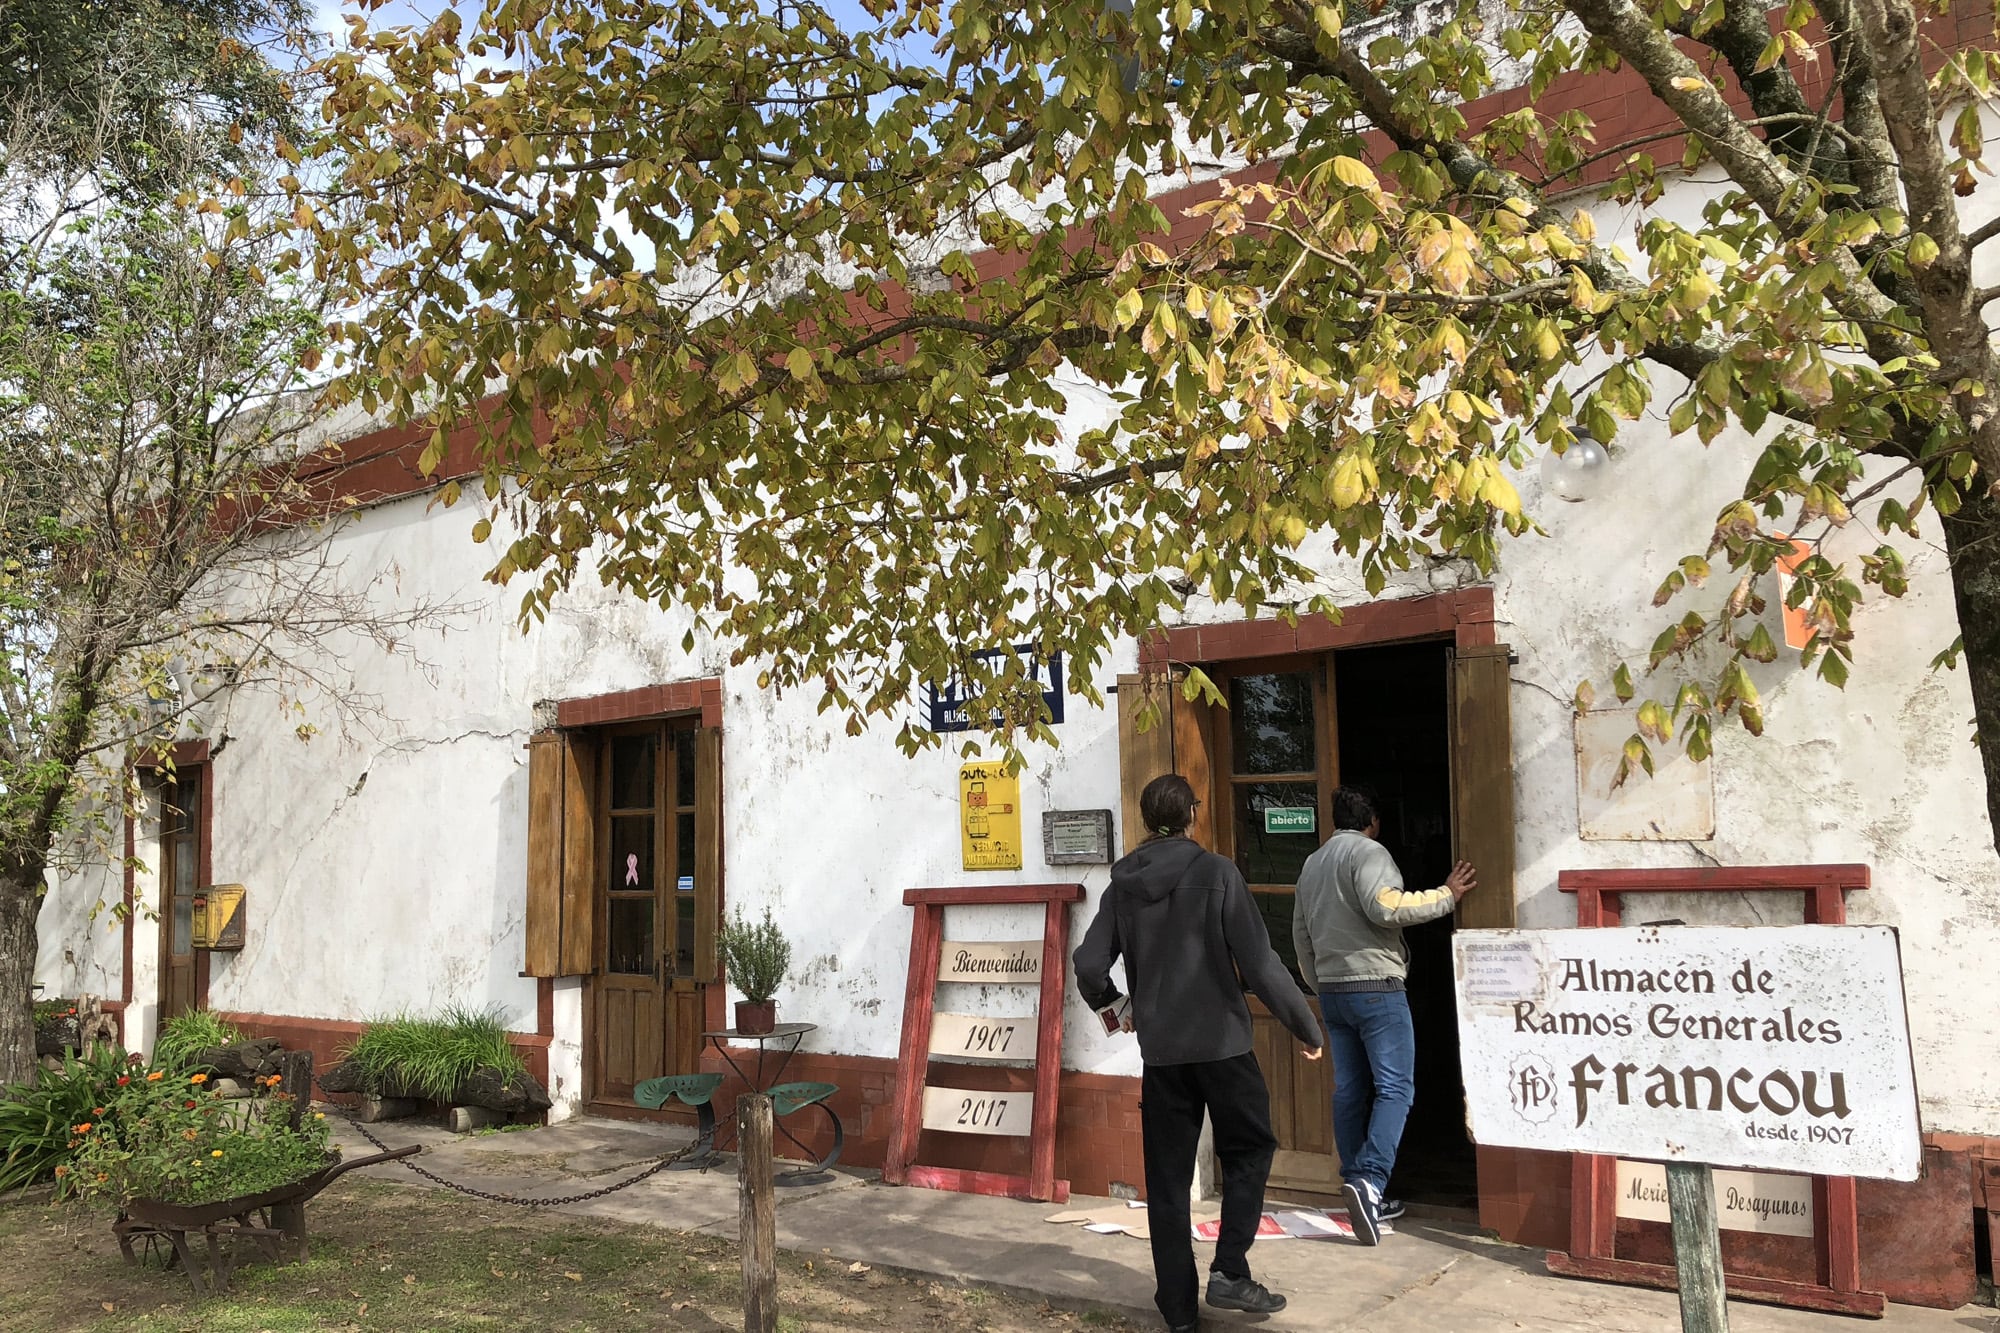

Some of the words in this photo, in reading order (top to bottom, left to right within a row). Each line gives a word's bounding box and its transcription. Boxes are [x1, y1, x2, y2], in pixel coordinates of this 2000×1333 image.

[1271, 815, 1309, 825] abierto
[952, 948, 1038, 974] Bienvenidos
[1558, 957, 1715, 994] Almacén
[1732, 962, 1775, 995] de
[1512, 1000, 1632, 1037] Ramos
[1648, 1002, 1843, 1044] Generales
[964, 1024, 1015, 1053] 1907
[957, 1098, 1008, 1127] 2017
[1745, 1121, 1798, 1142] desde
[1806, 1124, 1855, 1146] 1907
[1626, 1177, 1669, 1204] Merie
[1726, 1186, 1807, 1221] Desayunos
